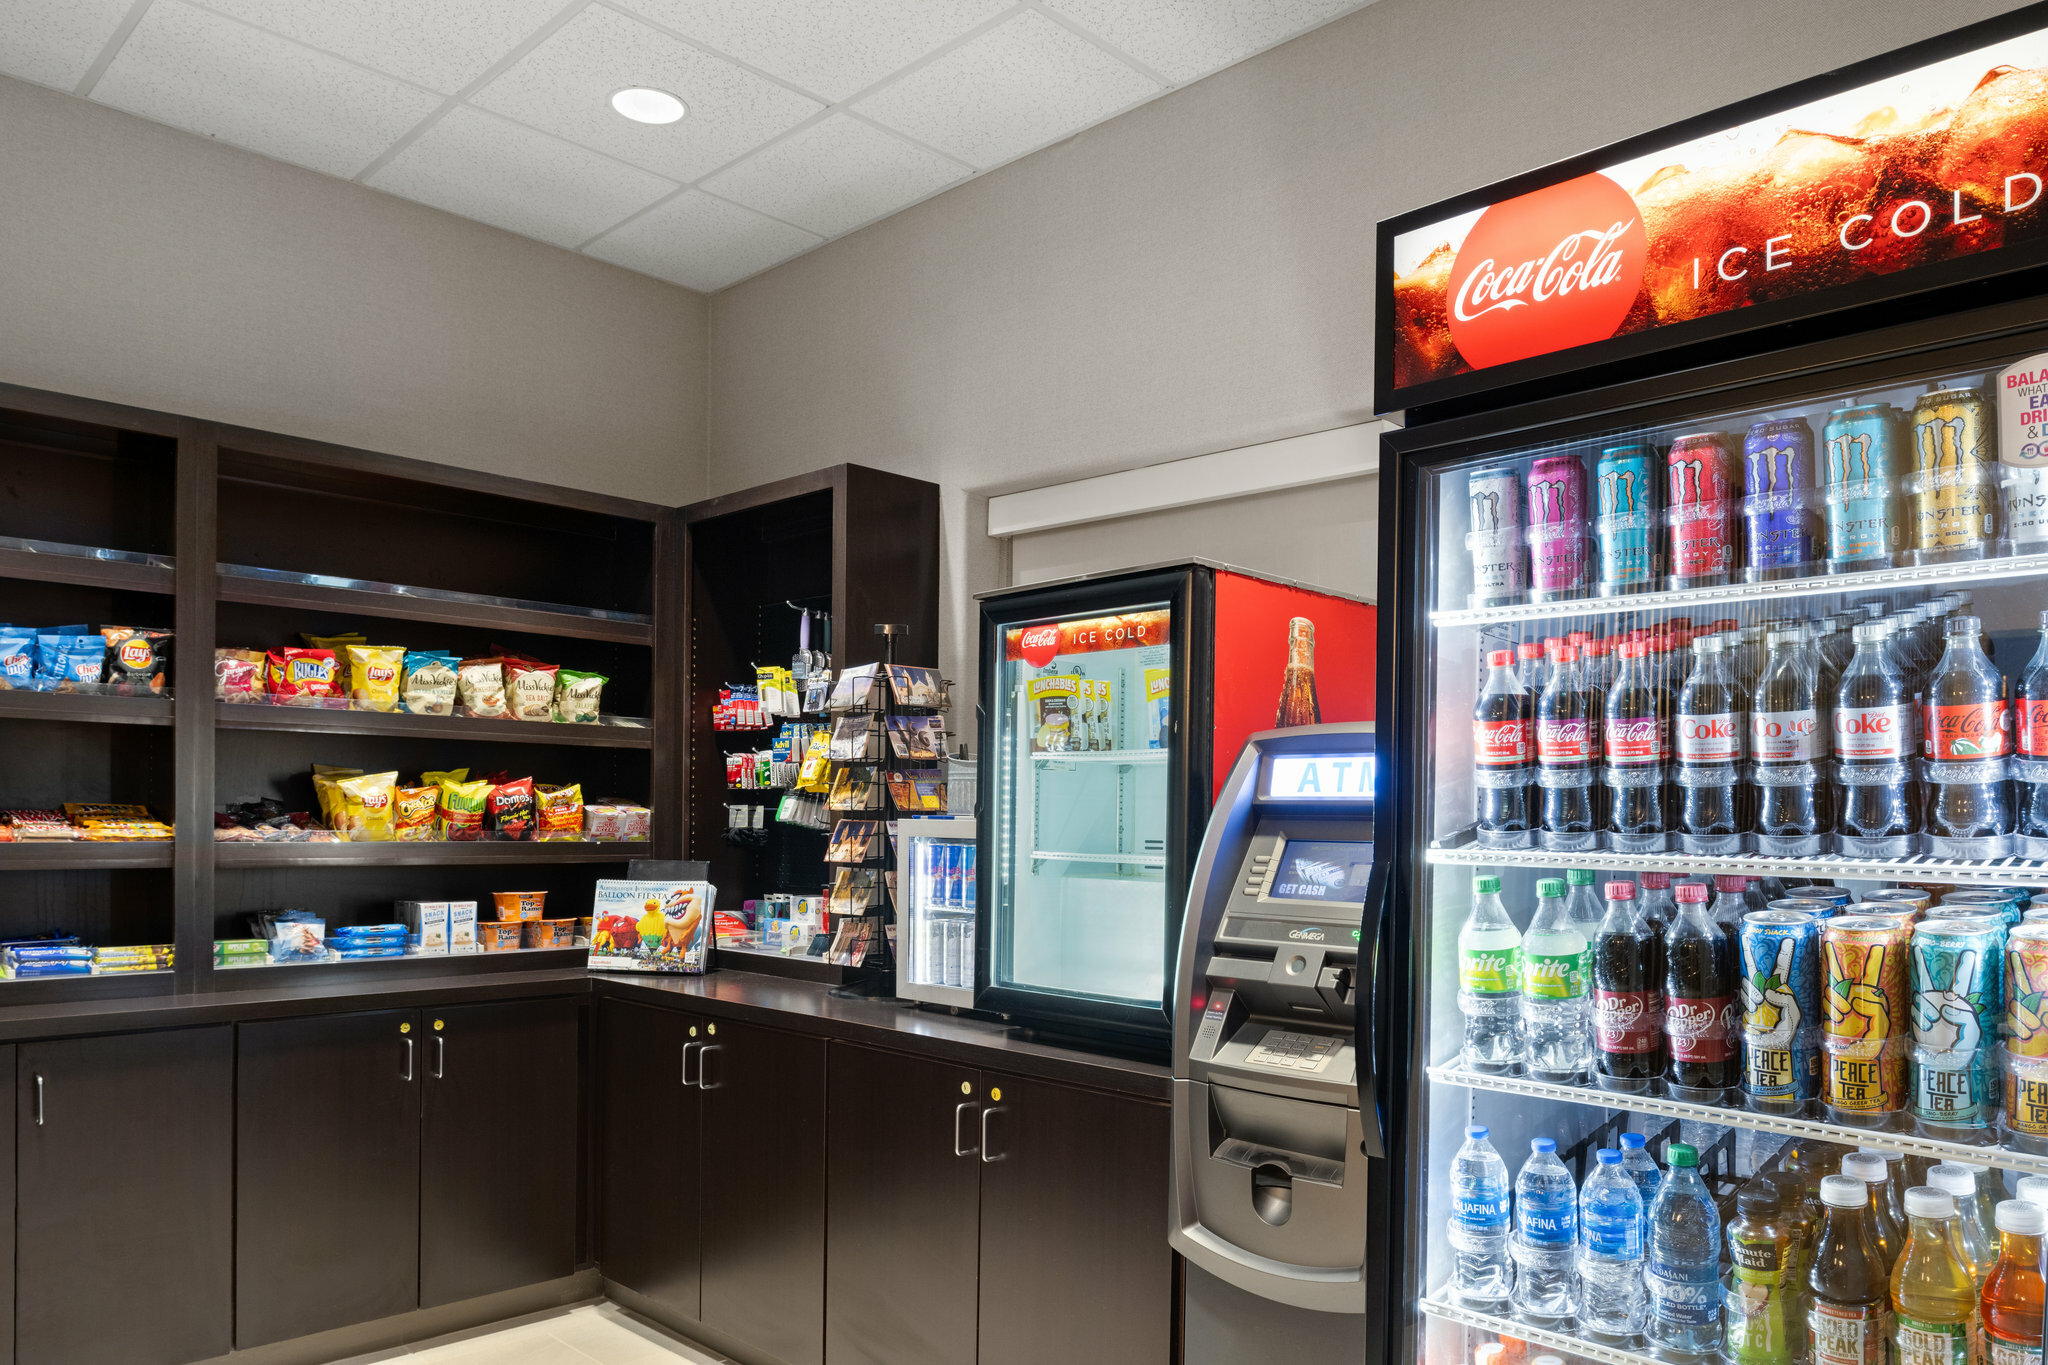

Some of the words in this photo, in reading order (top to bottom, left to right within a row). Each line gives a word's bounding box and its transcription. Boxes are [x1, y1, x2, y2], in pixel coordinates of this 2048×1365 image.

[1454, 216, 1636, 322] Coca-Cola
[1693, 234, 1793, 290] ICE
[1839, 171, 2043, 252] COLD
[1937, 392, 1971, 400] SUGAR
[1769, 423, 1800, 432] SUGAR
[2027, 425, 2039, 439] &
[1916, 505, 1982, 521] ONSTER
[1836, 517, 1889, 533] NSTER
[1840, 532, 1880, 542] ERGY
[1945, 529, 1968, 537] BOLD
[1676, 536, 1720, 551] STER
[1538, 553, 1582, 566] NSTER
[1608, 546, 1651, 560] NSTER
[1477, 562, 1515, 574] NSTER
[1542, 565, 1573, 574] ERGY
[1021, 628, 1058, 648] Coca-Cola
[1073, 631, 1097, 645] ICE
[1105, 625, 1146, 641] COLD
[4, 654, 31, 666] Chex
[124, 646, 151, 663] Lay's
[76, 663, 102, 676] Chex
[293, 660, 329, 681] BUGLES
[369, 666, 394, 682] Lay's
[411, 674, 432, 685] Miss
[516, 679, 535, 691] Miss
[1033, 678, 1078, 695] LUNCHABLES
[525, 694, 536, 702] SEA
[1867, 711, 1885, 719] Diet
[1928, 705, 2001, 733] Coca-Cola
[1682, 719, 1737, 739] Coke
[1835, 711, 1892, 735] Coke
[1474, 723, 1525, 744] oca-Cola
[1606, 720, 1660, 743] Coca-Cola
[773, 740, 790, 749] Advil
[399, 794, 436, 818] Cheetos
[496, 793, 530, 806] Doritos
[598, 890, 635, 899] BALLOON
[1278, 883, 1299, 895] GET
[1299, 884, 1327, 896] CASH
[520, 900, 535, 908] Top
[798, 901, 807, 913] all
[497, 928, 513, 936] Top
[1288, 929, 1325, 941] GENMEGA
[1464, 953, 1506, 978] prite
[1608, 997, 1627, 1009] Dr
[1680, 1004, 1698, 1016] Dr
[1748, 1047, 1789, 1072] PEACE
[1754, 1069, 1781, 1086] TEA
[1835, 1060, 1877, 1084] PEACE
[1922, 1068, 1967, 1094] PEACE
[1839, 1081, 1869, 1100] TEA
[1926, 1091, 1958, 1111] TEA
[1583, 1226, 1603, 1245] FINA
[1659, 1269, 1689, 1281] DASANI
[1657, 1281, 1707, 1304] 00%
[1746, 1319, 1765, 1331] 0%
[1819, 1333, 1858, 1354] PEAK
[1904, 1328, 1946, 1353] GOLD
